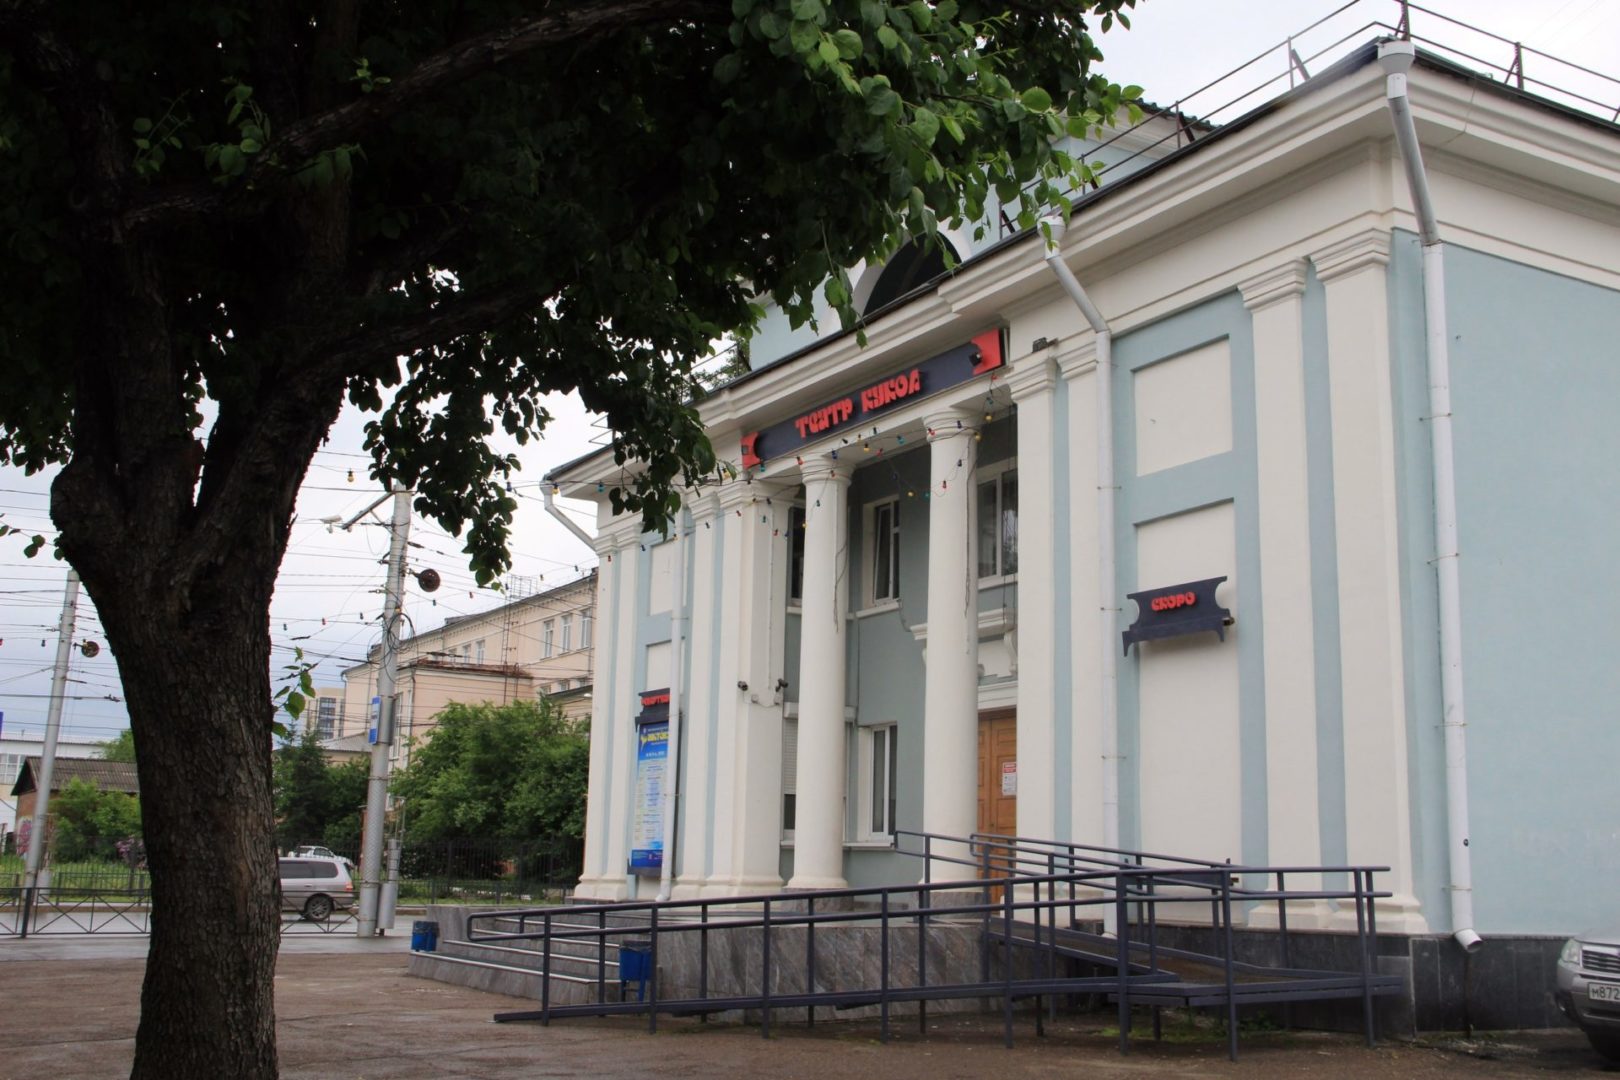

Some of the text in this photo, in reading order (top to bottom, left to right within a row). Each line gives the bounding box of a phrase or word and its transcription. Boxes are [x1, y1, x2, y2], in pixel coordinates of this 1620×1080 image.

[795, 369, 921, 438] ТЕАТР КУКОЛ
[1151, 592, 1196, 611] СКОРО
